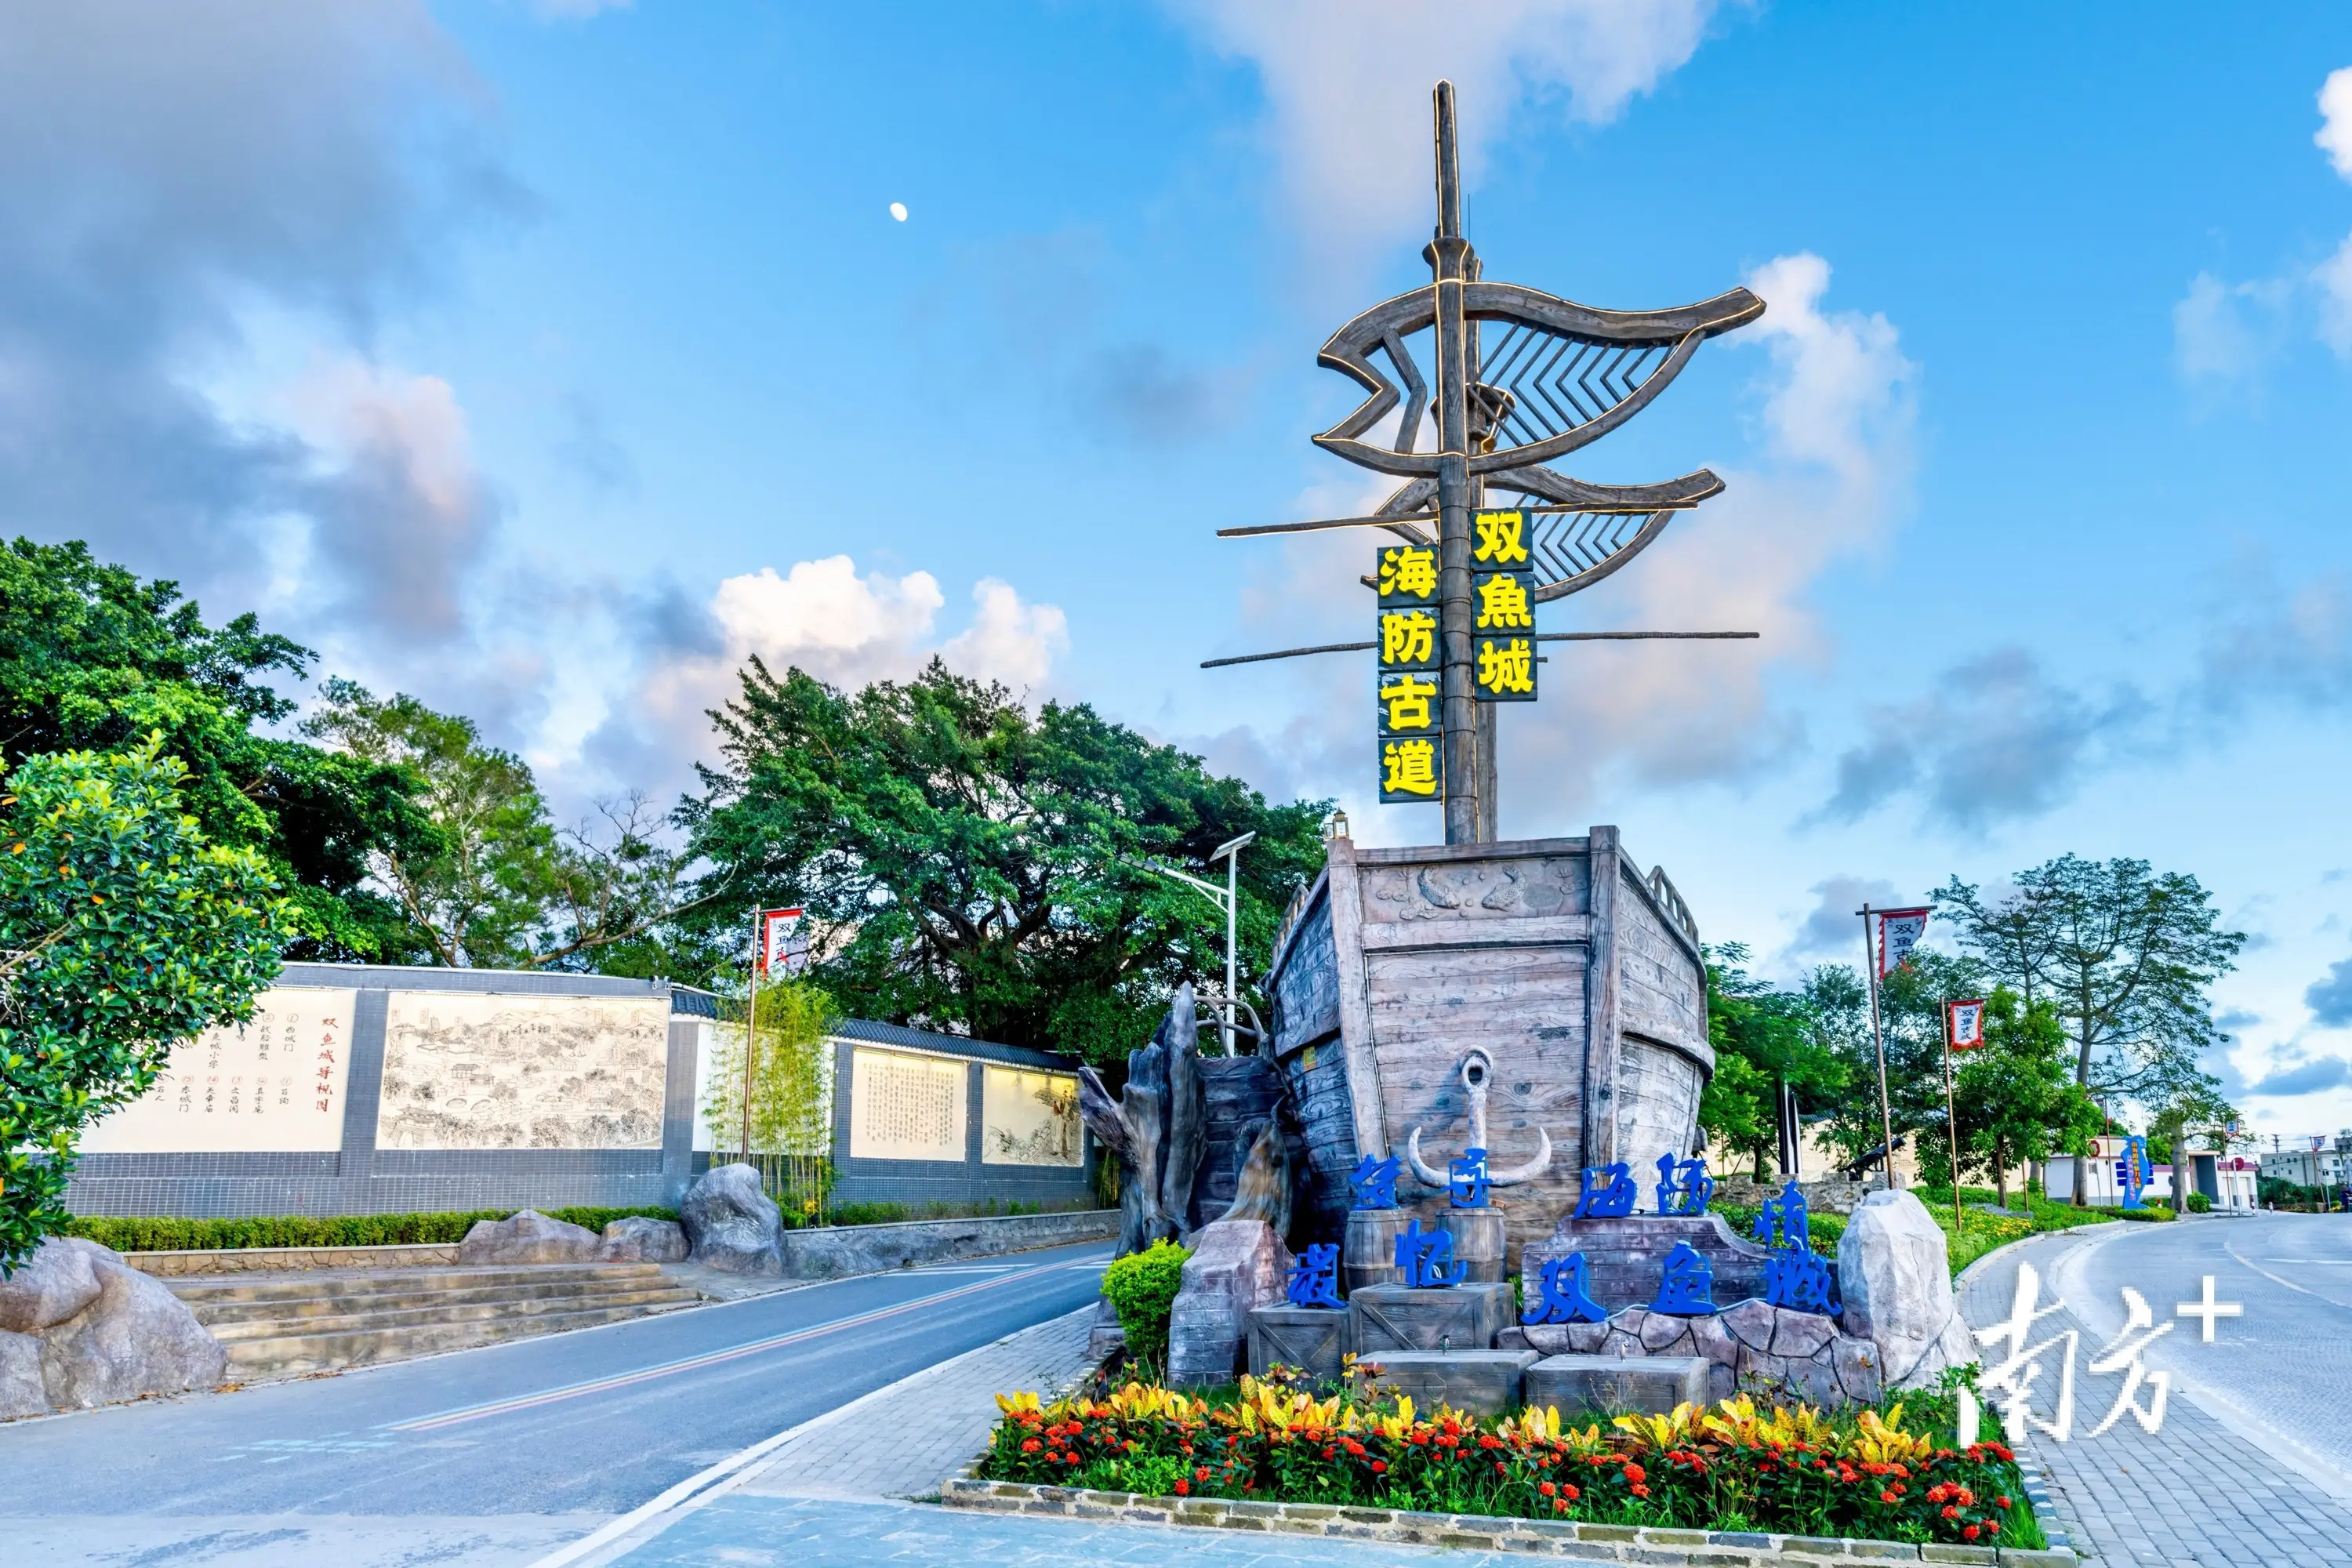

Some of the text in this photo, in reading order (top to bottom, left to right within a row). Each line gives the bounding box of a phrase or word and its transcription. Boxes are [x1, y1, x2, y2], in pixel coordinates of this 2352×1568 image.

[1379, 546, 1437, 796] 海防古道
[1474, 510, 1534, 694] 双魚城
